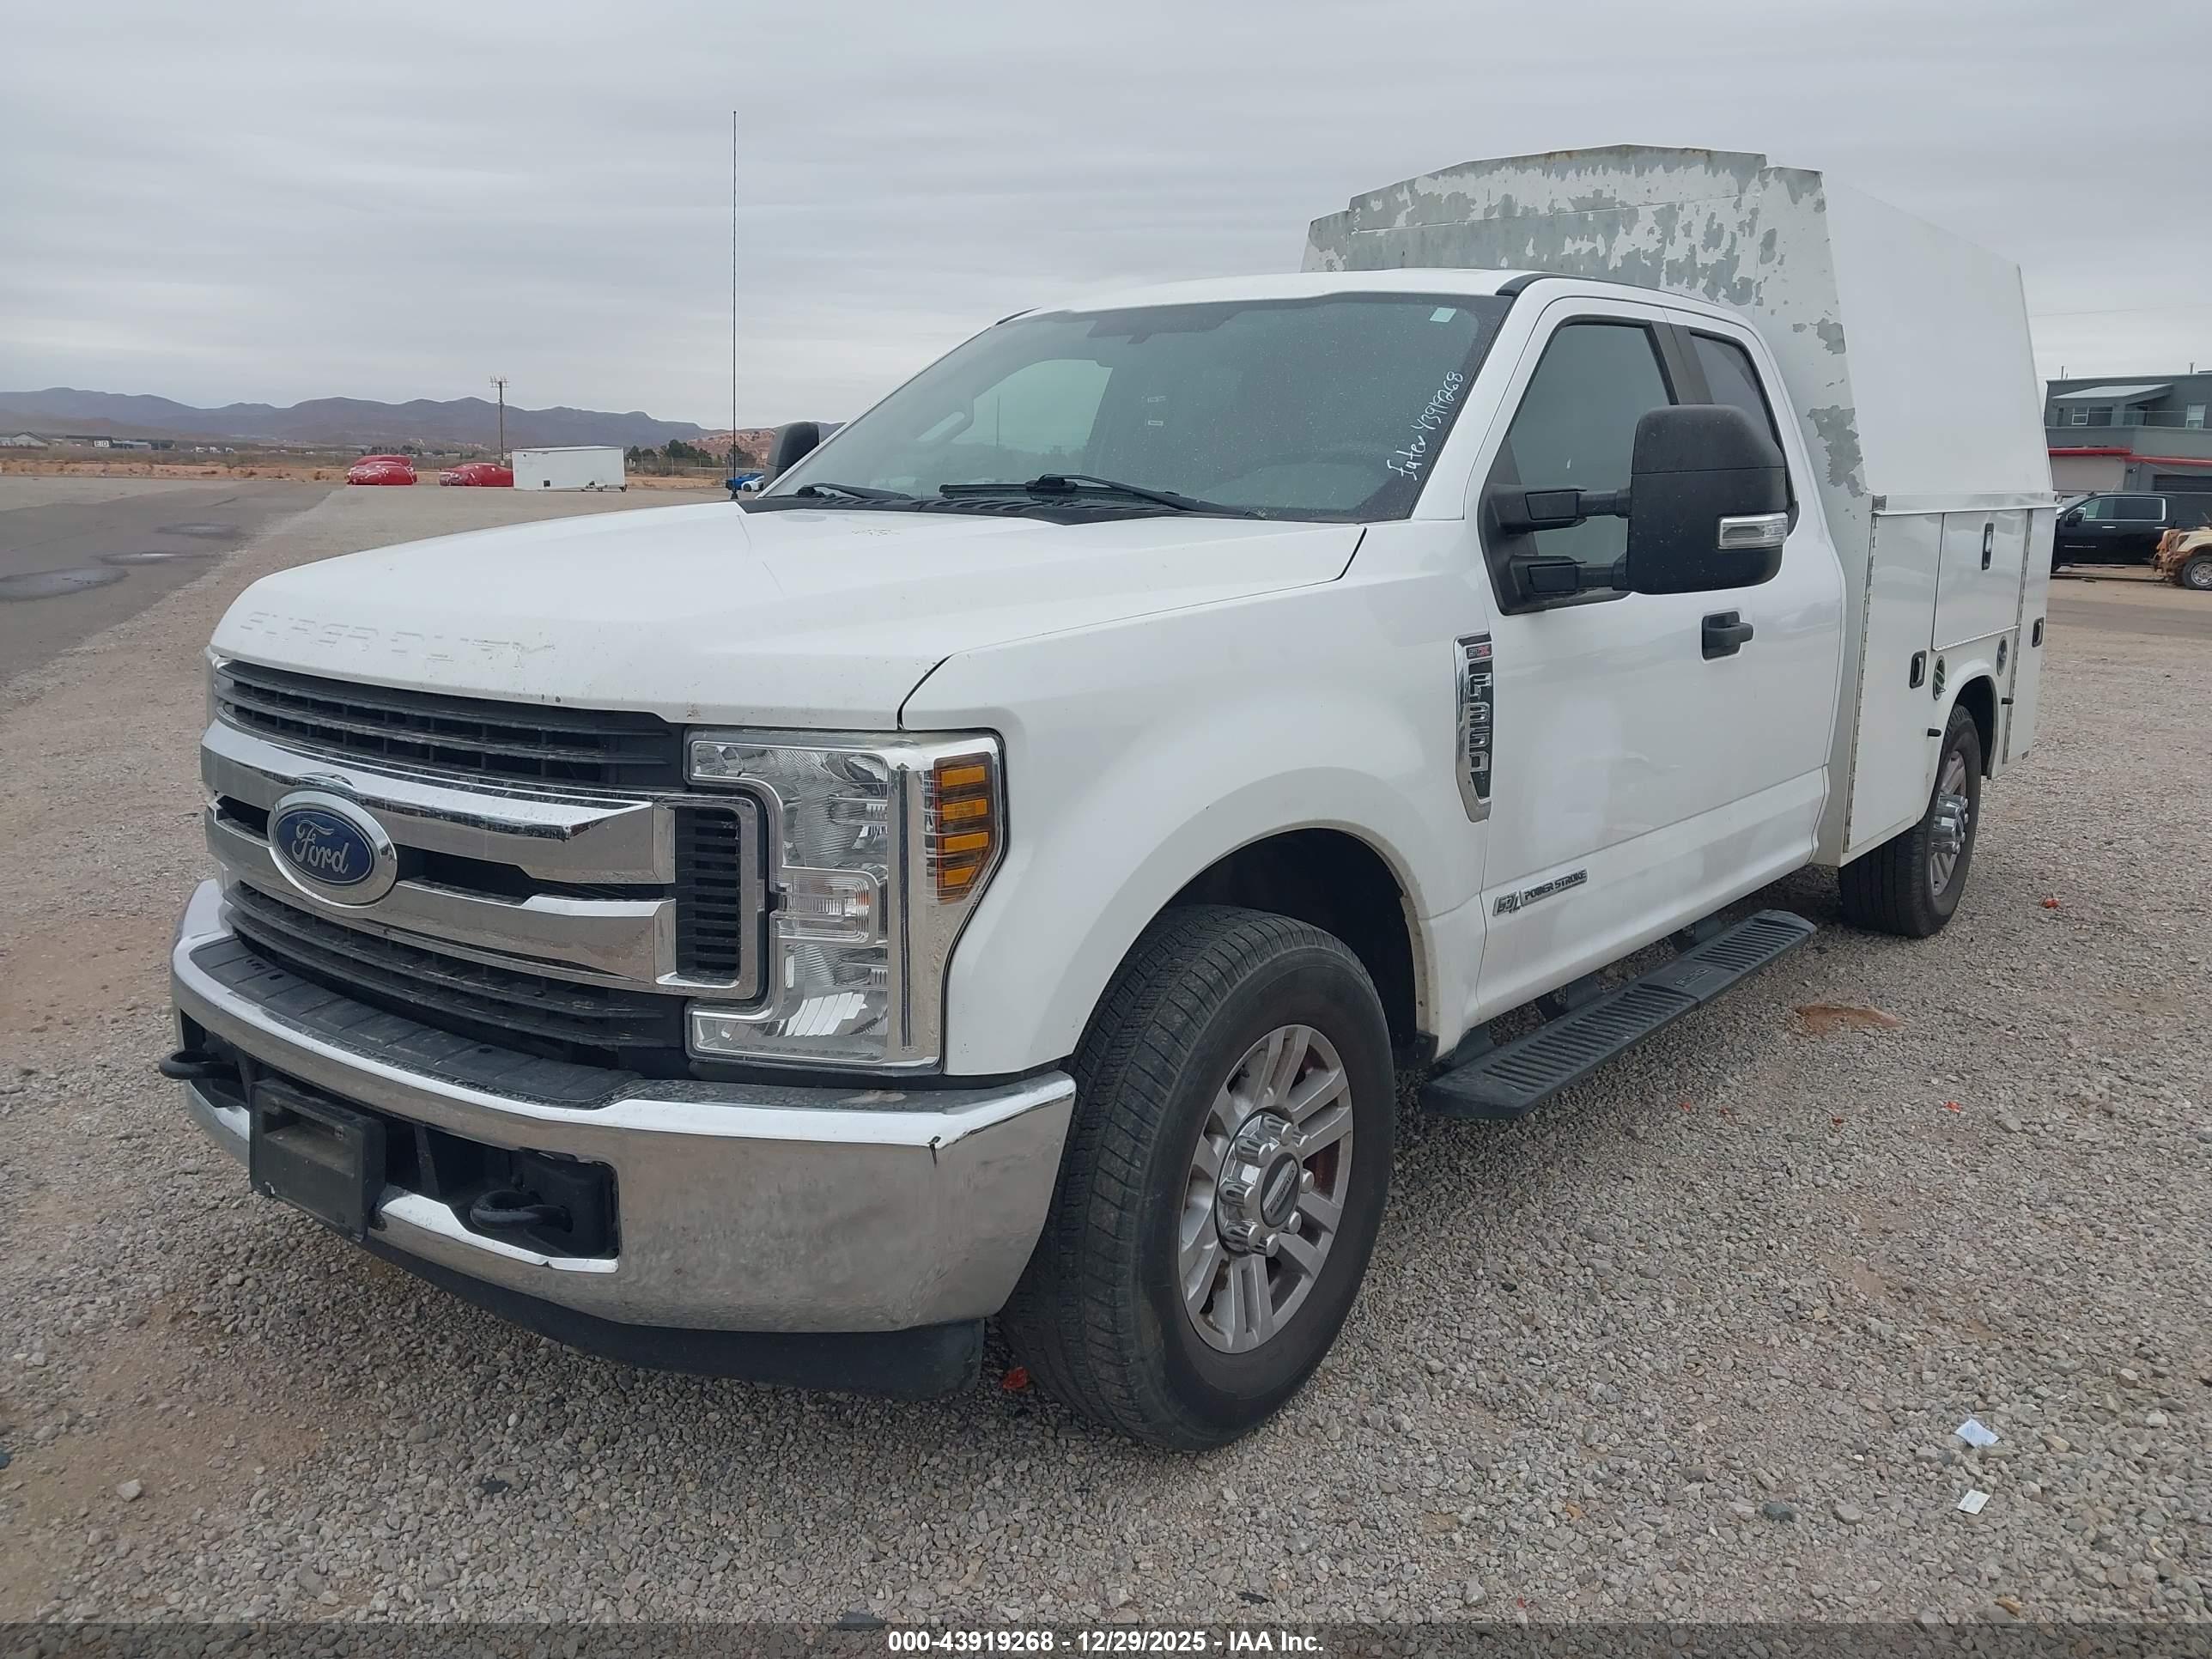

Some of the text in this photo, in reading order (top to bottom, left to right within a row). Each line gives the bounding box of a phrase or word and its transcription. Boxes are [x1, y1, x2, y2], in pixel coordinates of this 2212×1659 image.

[291, 819, 349, 874] Ford
[1524, 882, 1554, 901] POWER
[1554, 869, 1587, 890] STROKE
